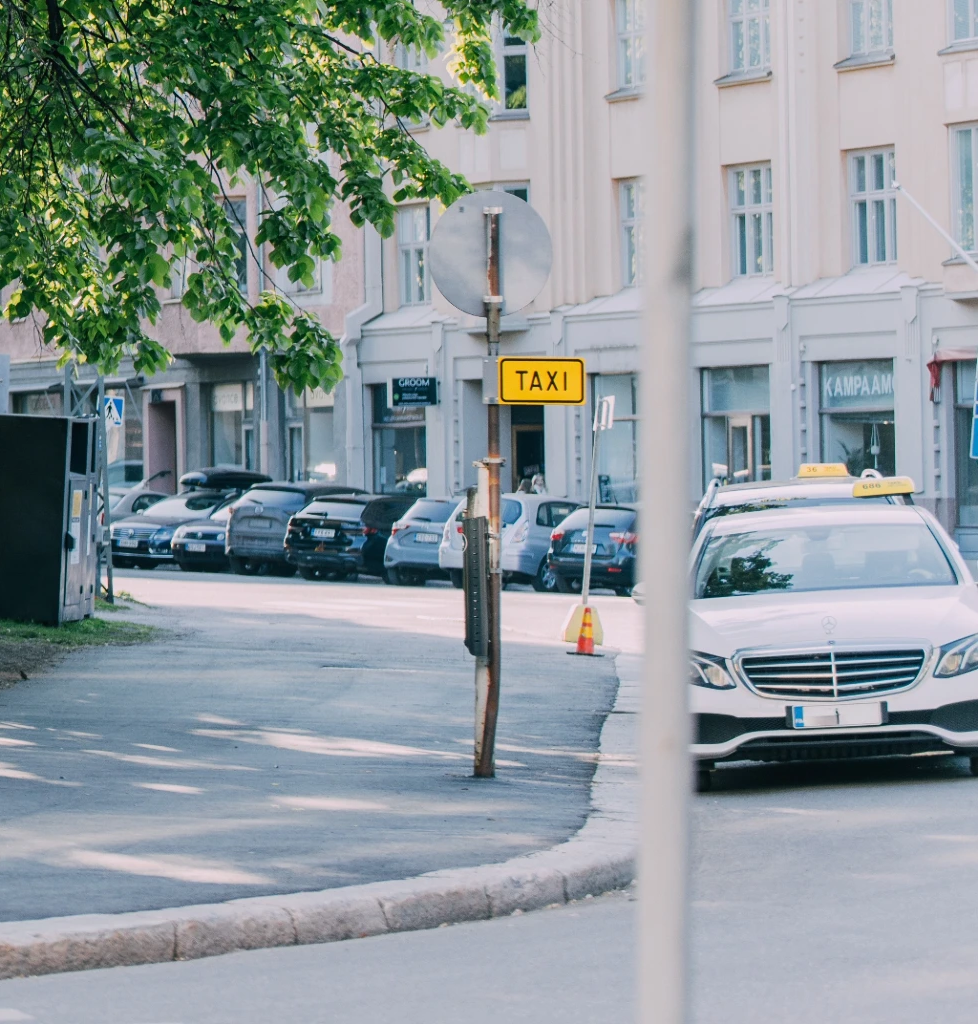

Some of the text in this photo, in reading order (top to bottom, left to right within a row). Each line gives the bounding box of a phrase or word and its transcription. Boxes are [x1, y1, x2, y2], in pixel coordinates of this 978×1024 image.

[398, 377, 430, 387] GROOM
[515, 370, 567, 391] TAXI
[823, 373, 894, 397] KAMPAAM
